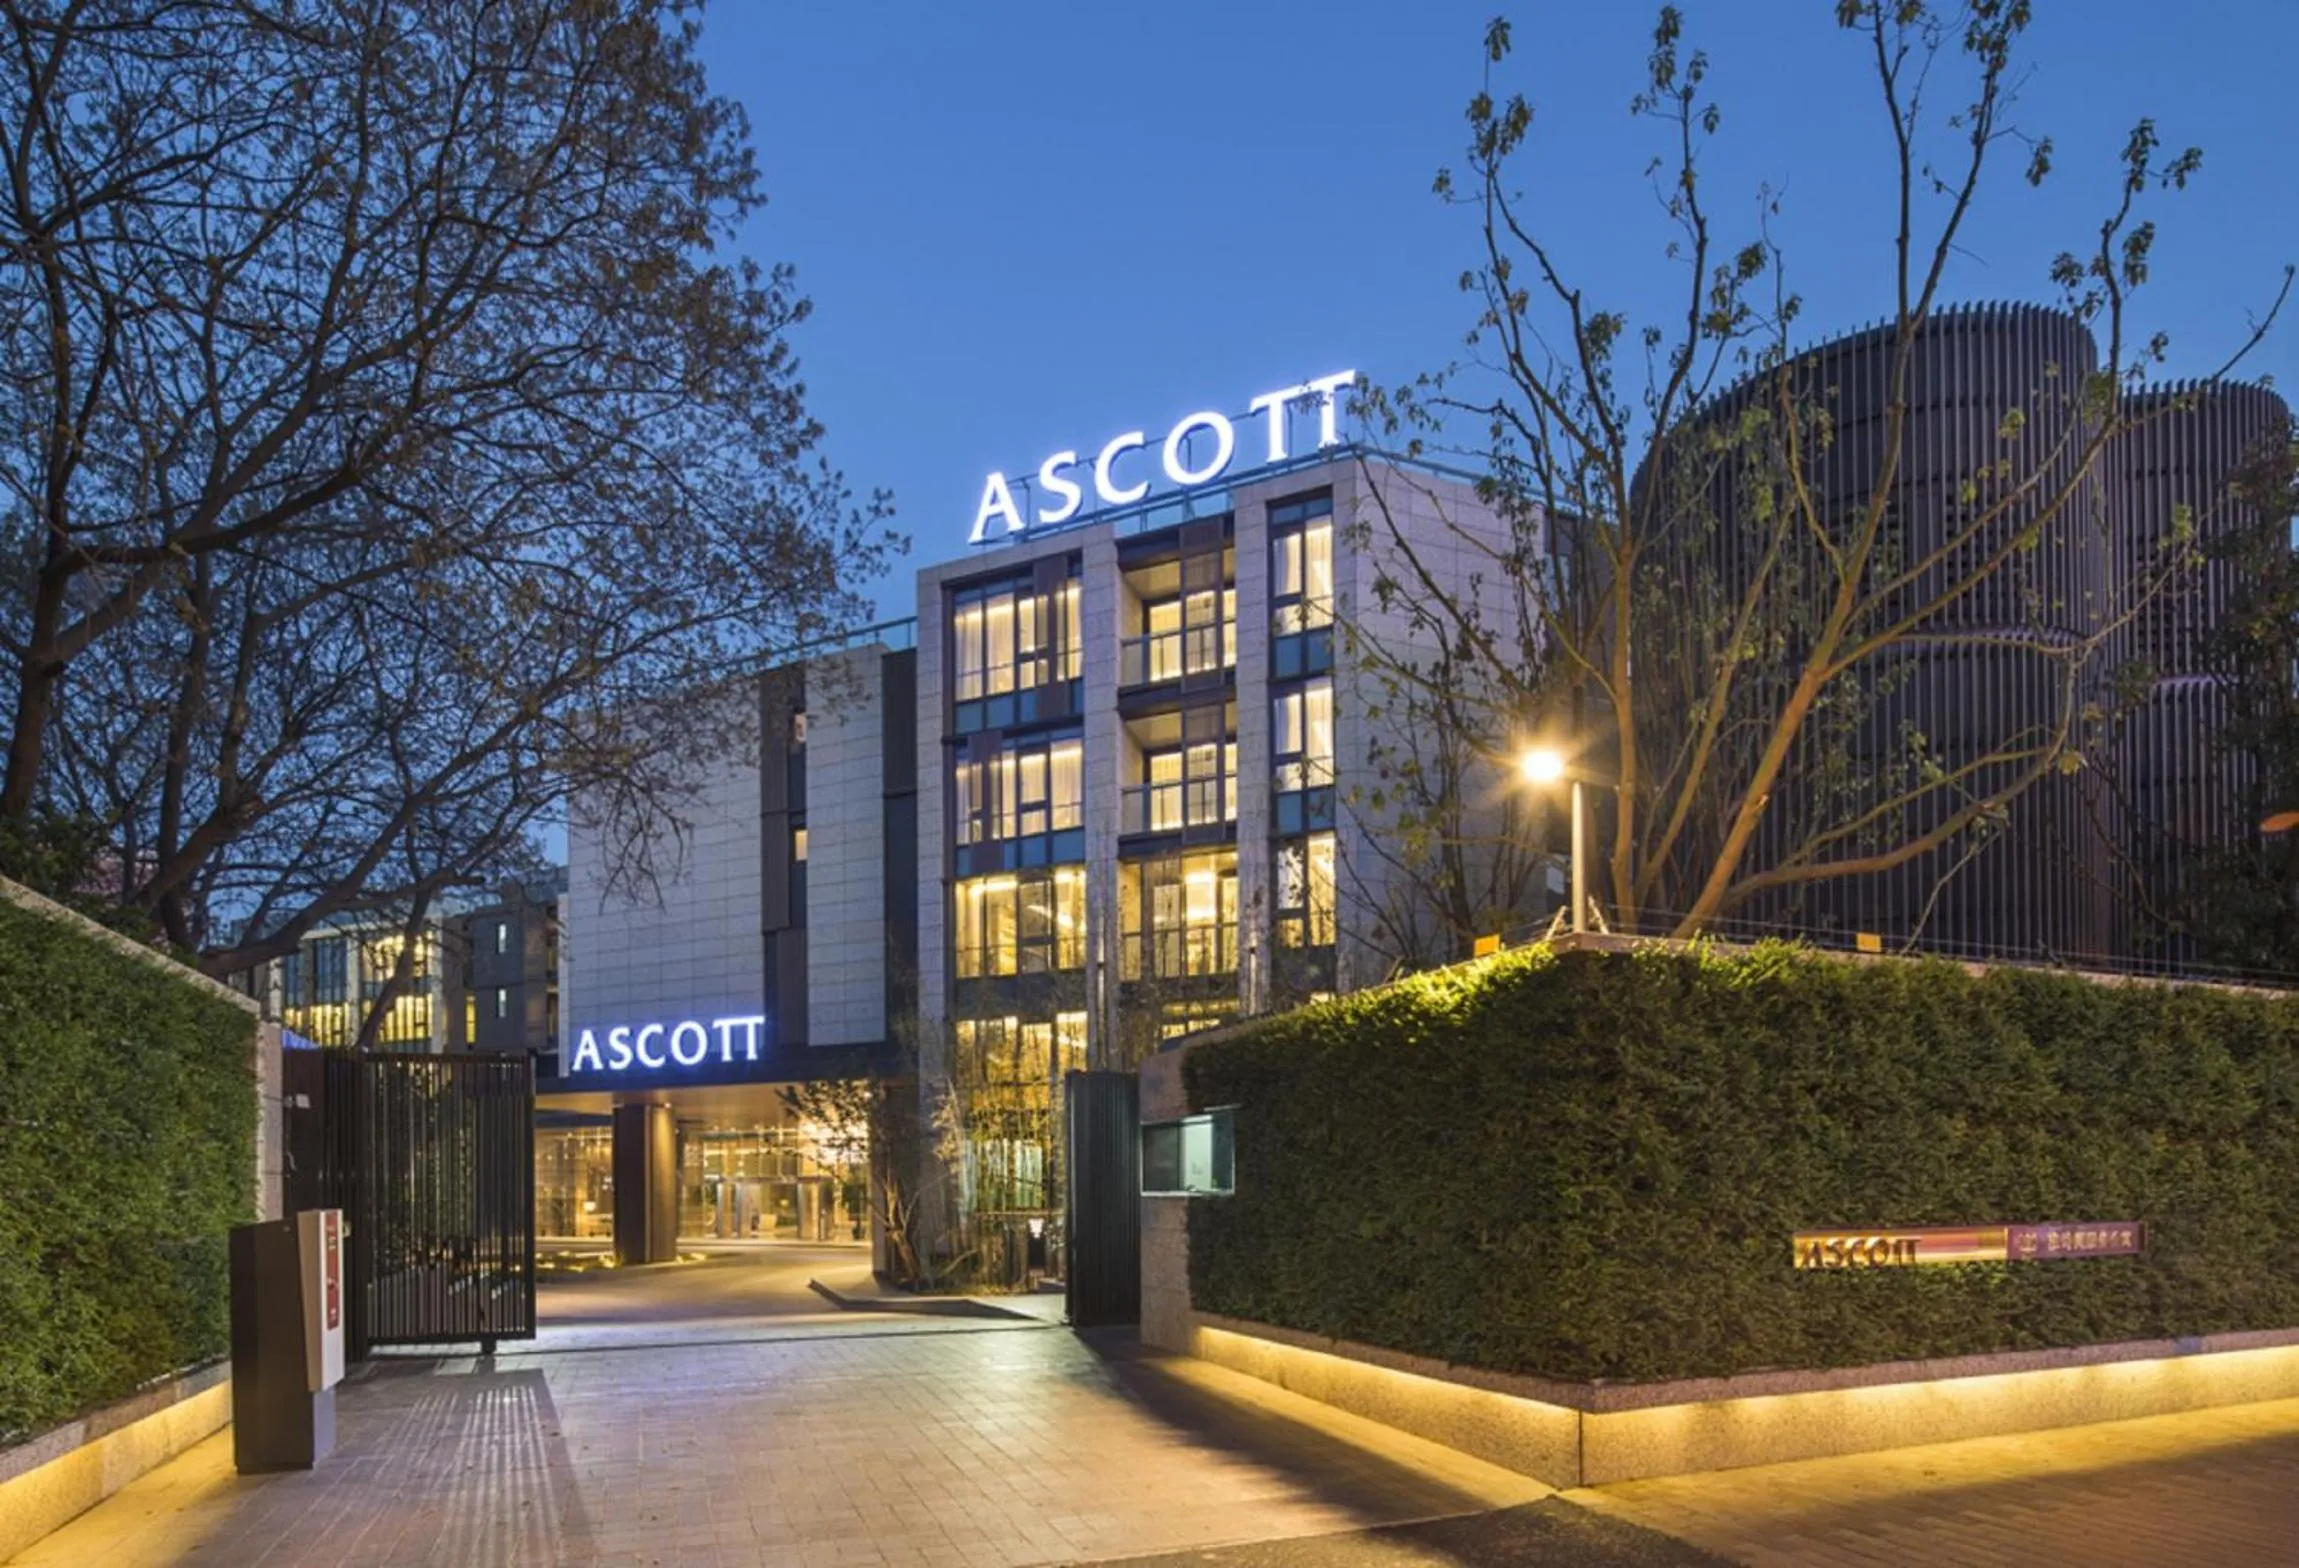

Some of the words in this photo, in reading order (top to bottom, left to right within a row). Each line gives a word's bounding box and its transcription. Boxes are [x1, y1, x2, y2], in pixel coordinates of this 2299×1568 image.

[969, 369, 1356, 544] ASCOTT
[572, 1016, 765, 1071] ASCOTT
[1801, 1237, 1921, 1268] ASCOTT
